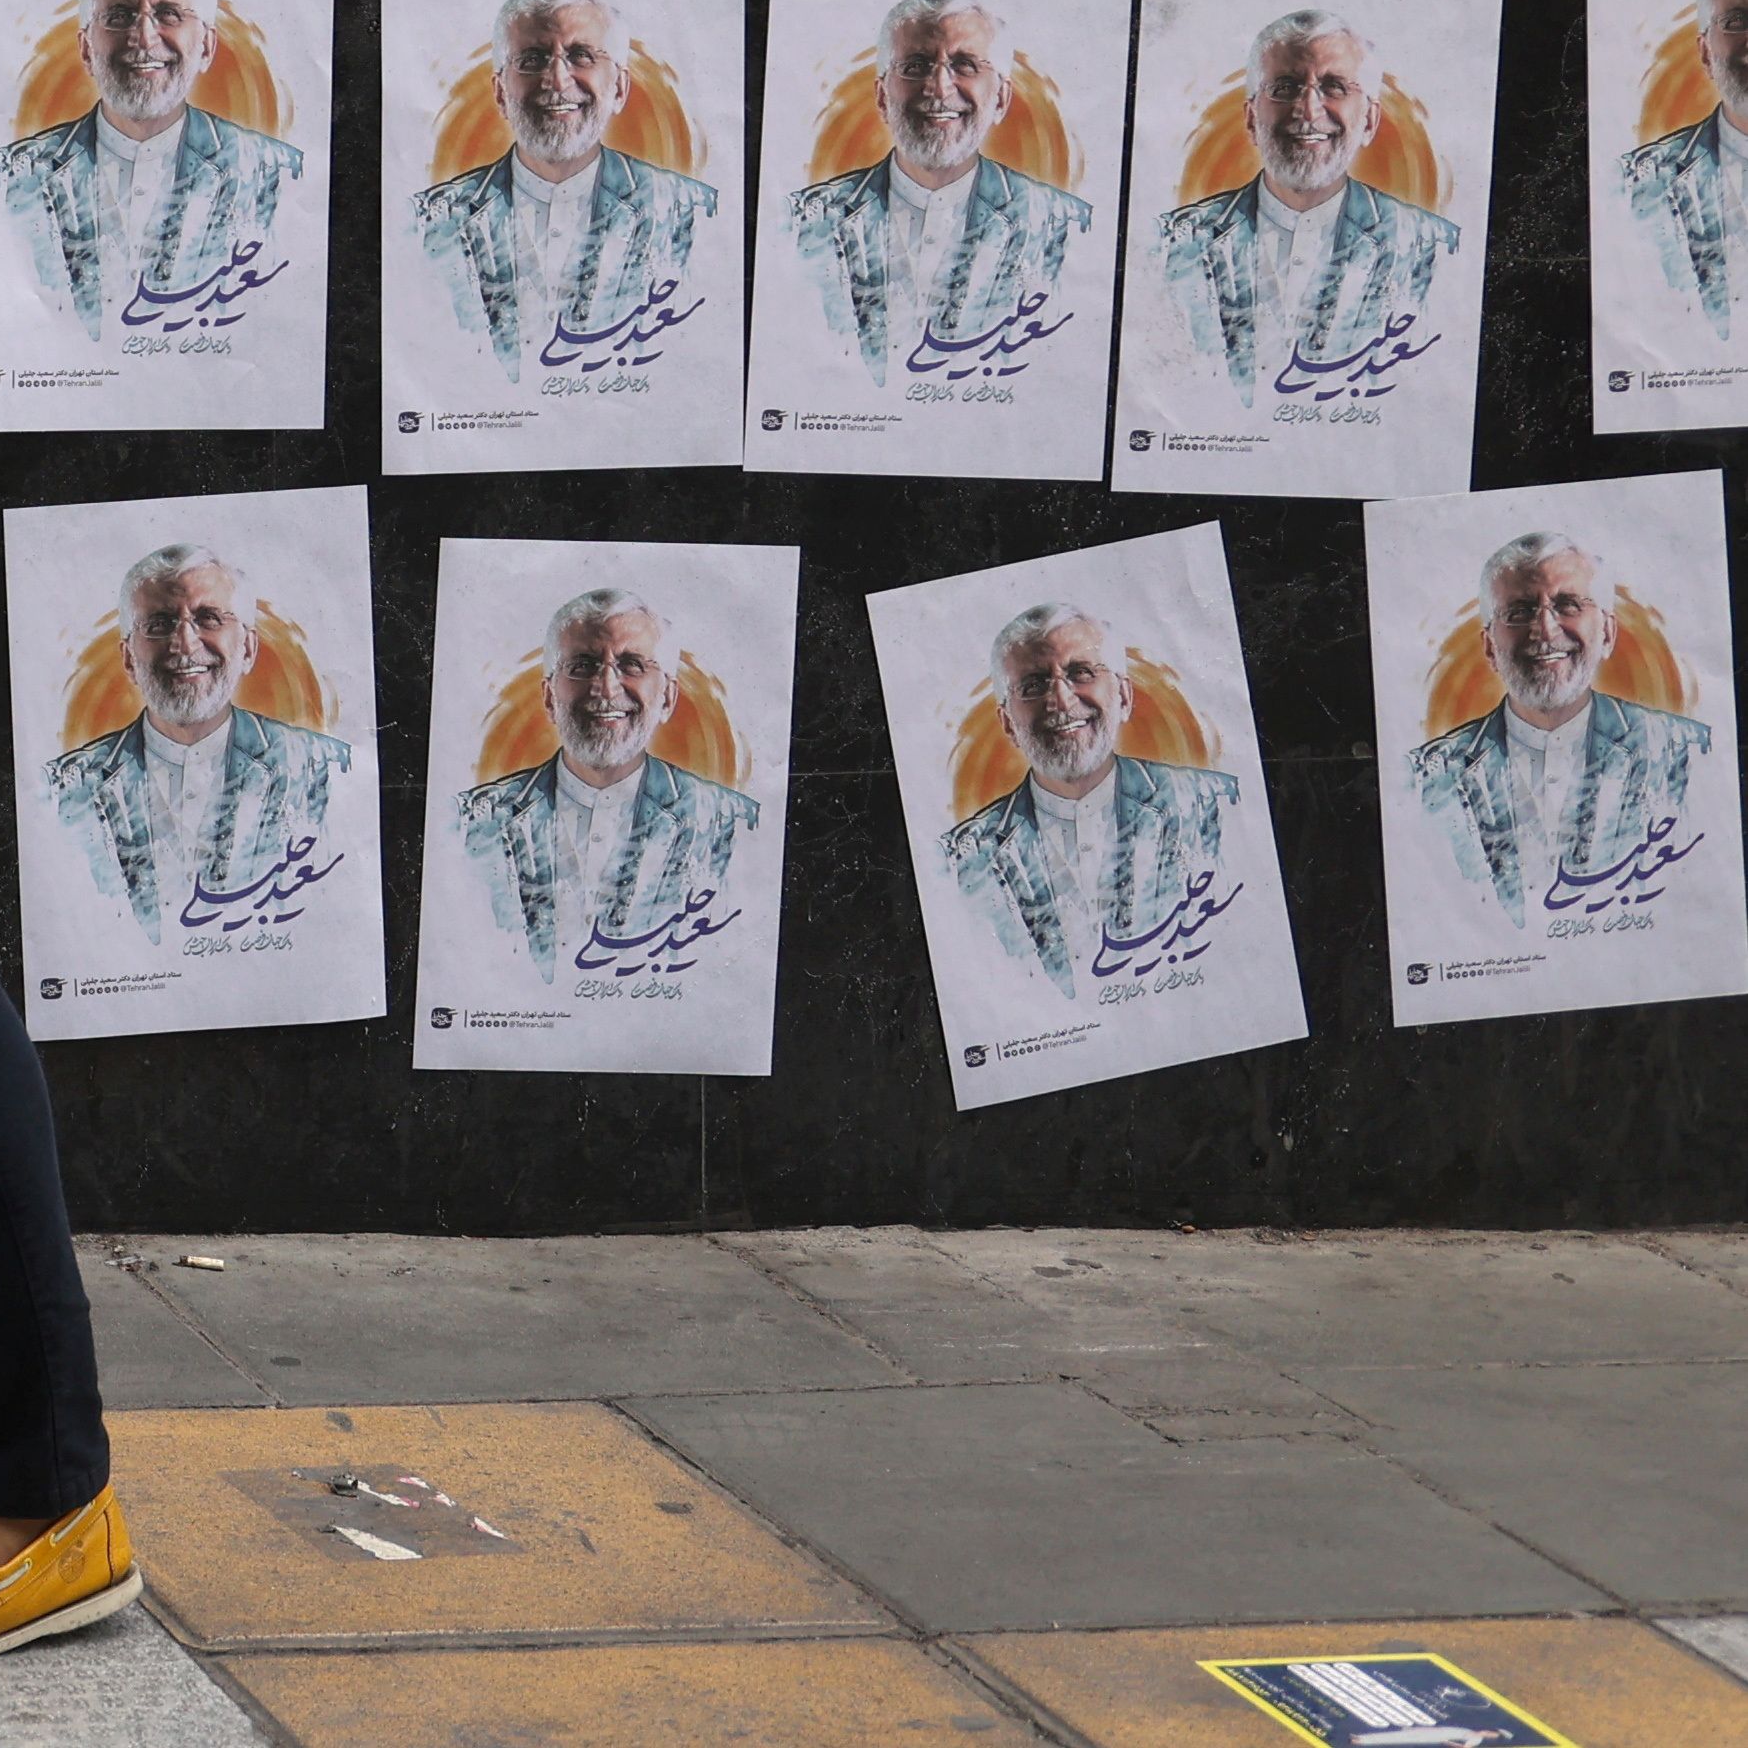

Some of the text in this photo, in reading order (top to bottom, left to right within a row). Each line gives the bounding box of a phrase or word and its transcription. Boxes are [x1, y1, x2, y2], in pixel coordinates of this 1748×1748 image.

[120, 238, 289, 333] سعید جلیلی
[539, 277, 706, 373] سعید جلیلی
[905, 289, 1074, 381] سعید جلیلی
[1273, 311, 1442, 402] سعید جلیلی
[179, 833, 344, 932] سعید جلیلی
[1542, 815, 1704, 914] سعید جلیلی
[574, 886, 742, 977] سعید جلیلی
[1090, 869, 1244, 977] سعید جلیلی
